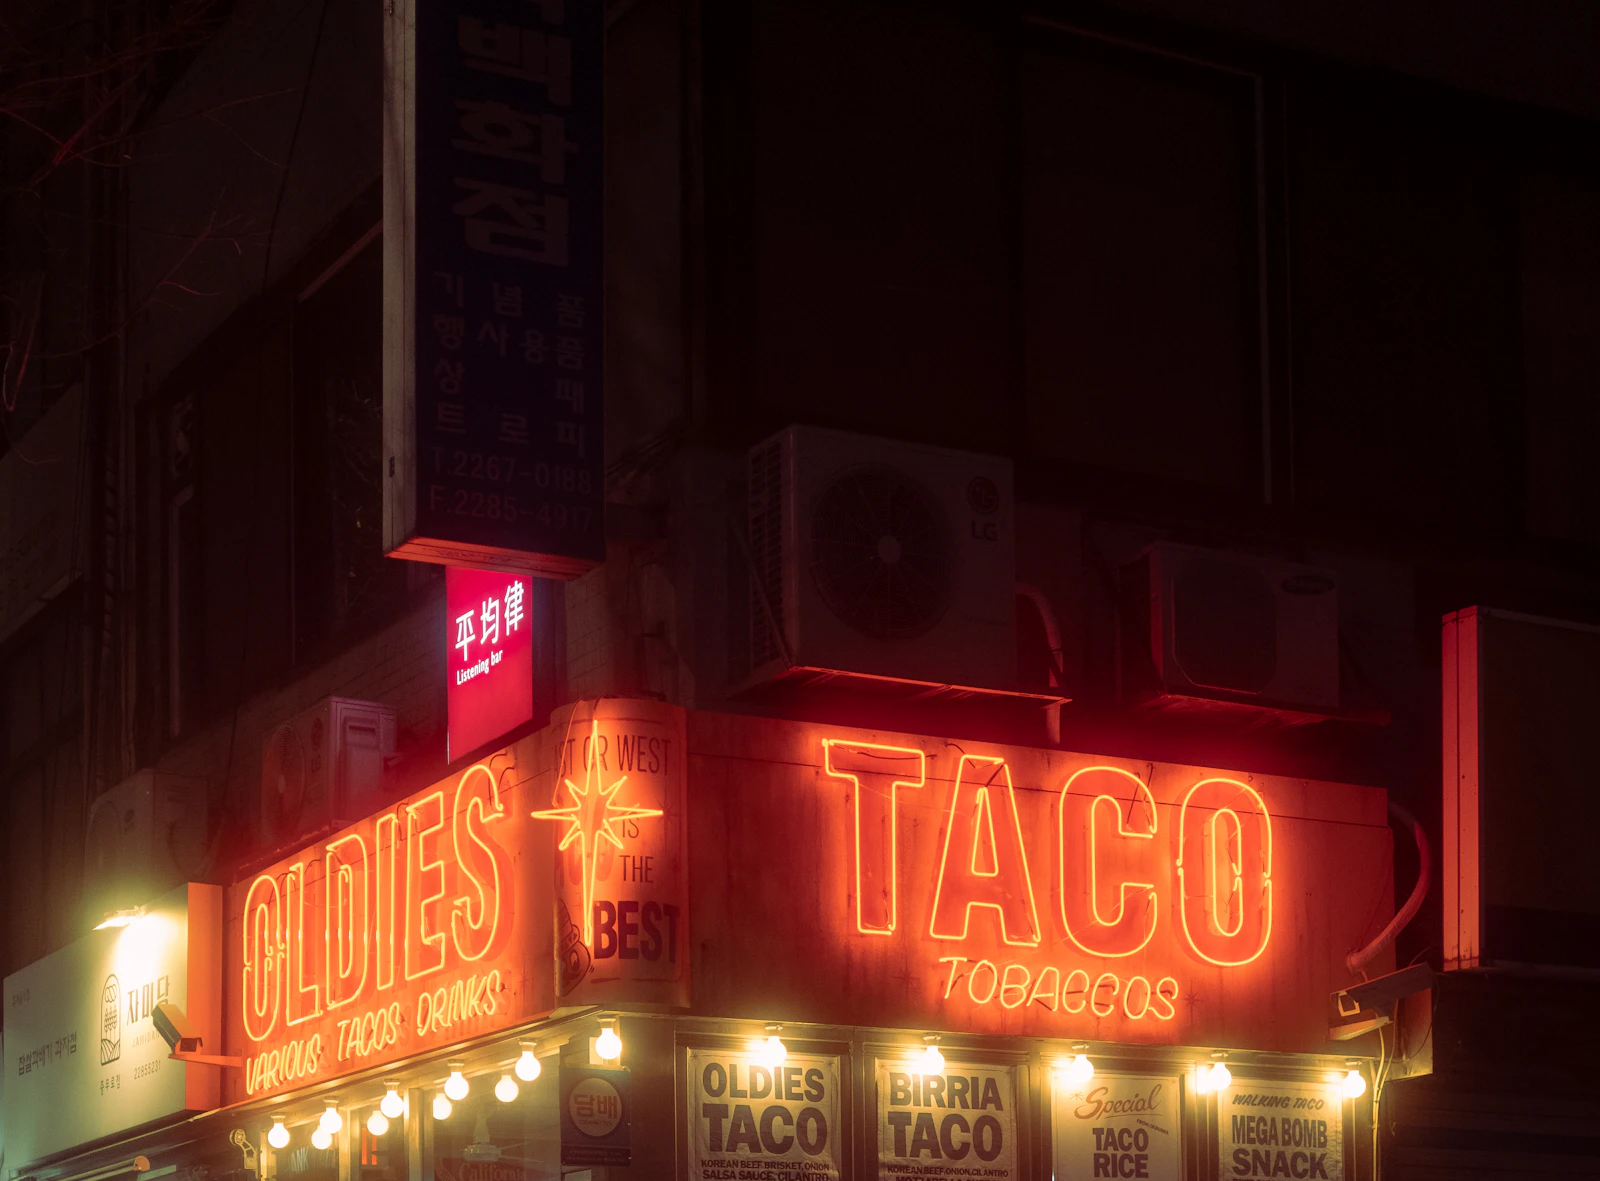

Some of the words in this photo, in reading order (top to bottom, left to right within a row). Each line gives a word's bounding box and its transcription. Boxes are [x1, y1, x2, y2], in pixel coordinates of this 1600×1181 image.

[451, 0, 578, 268] 백화점
[971, 519, 998, 542] LG
[455, 580, 524, 662] 平均律
[456, 656, 490, 686] Listening
[490, 650, 503, 667] bar
[617, 734, 671, 776] WEST
[619, 854, 655, 884] THE
[821, 738, 1272, 967] TACO
[242, 764, 504, 1042] OLDIES
[593, 900, 682, 964] BEST
[938, 956, 1179, 1020] TOBACCOS
[246, 1033, 322, 1096] VARIOUS
[337, 1002, 400, 1062] TACOS
[416, 969, 501, 1037] DRINKS
[702, 1061, 825, 1103] OLDIES
[889, 1072, 1004, 1112] BIRRIA
[573, 1094, 618, 1120] 담배
[1074, 1083, 1162, 1120] Special
[1232, 1094, 1291, 1109] WALKING
[1292, 1097, 1325, 1110] TACO
[702, 1103, 829, 1157] TACO
[888, 1111, 1003, 1162] TACO
[1092, 1127, 1149, 1152] TACO
[1232, 1114, 1279, 1146] MEGA
[1281, 1117, 1328, 1149] BOMB
[700, 1159, 739, 1169] KOREAN
[740, 1160, 763, 1170] BEEF
[702, 1170, 738, 1181] SALSA
[887, 1165, 922, 1175] KOREAN
[1093, 1153, 1149, 1178] RICE
[1232, 1148, 1329, 1180] SNACK
